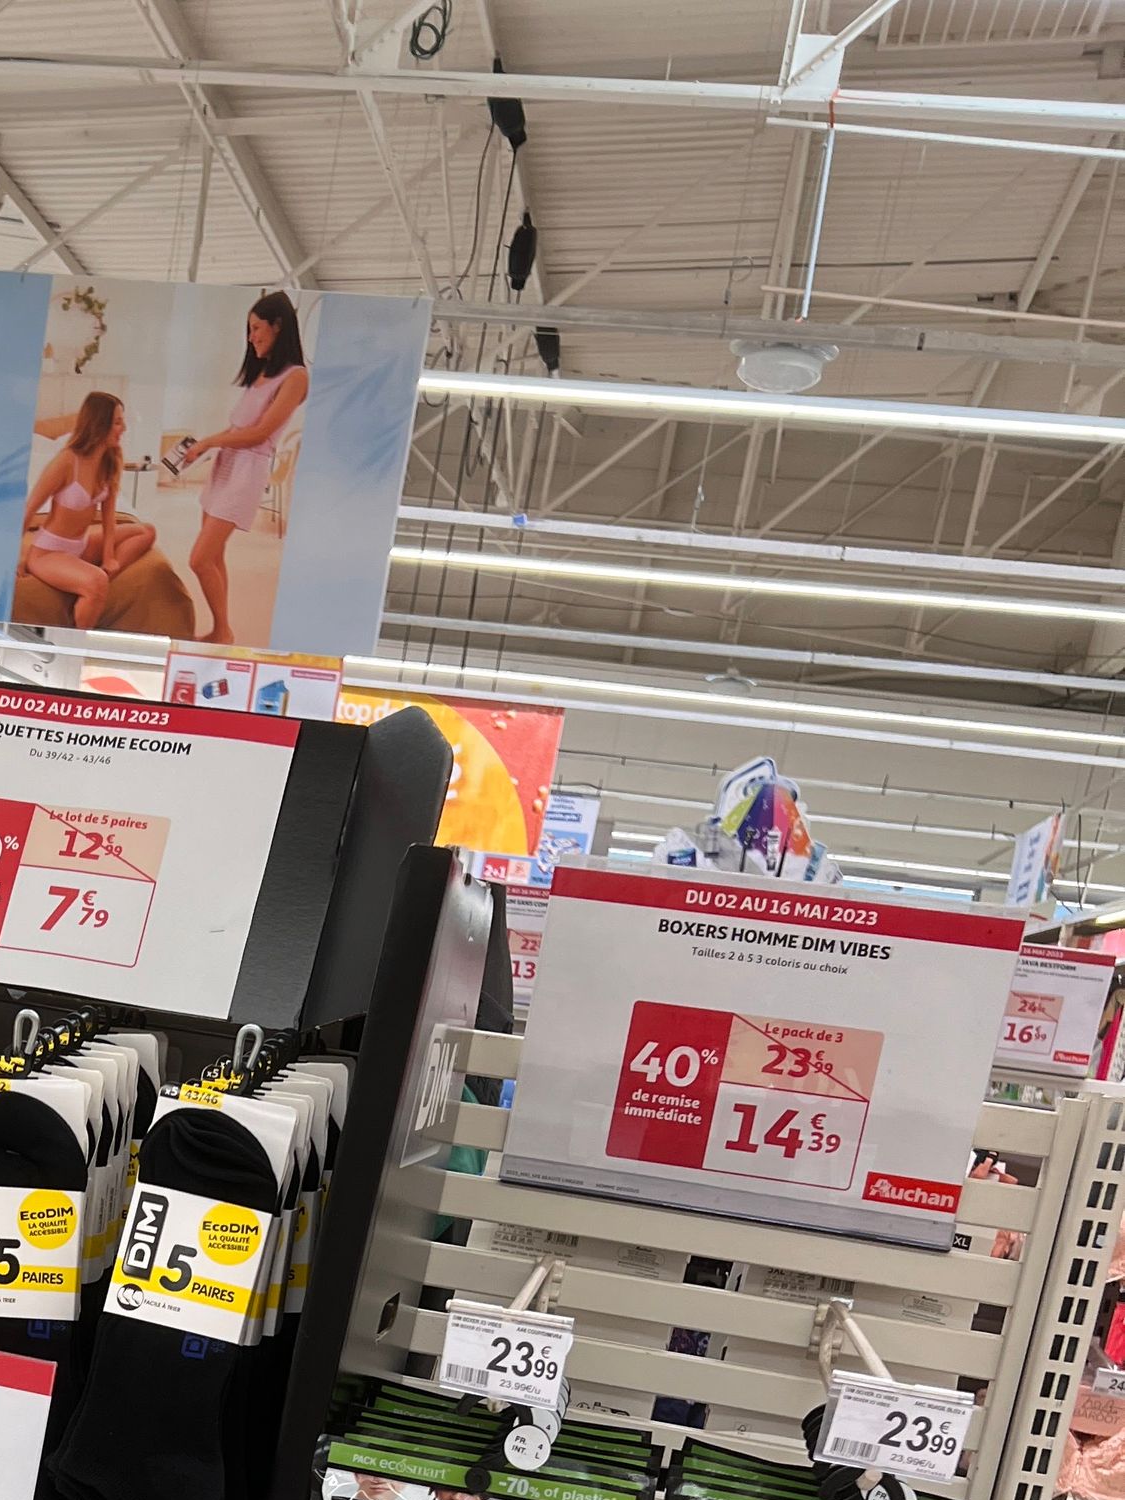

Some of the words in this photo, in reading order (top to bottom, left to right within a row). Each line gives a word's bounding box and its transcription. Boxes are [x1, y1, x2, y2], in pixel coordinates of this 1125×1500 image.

[24, 698, 45, 714] 02
[48, 700, 72, 717] AU
[74, 703, 93, 720] 16
[97, 706, 126, 723] MAI
[129, 708, 169, 726] 2023
[336, 699, 371, 722] top
[66, 731, 125, 750] HOMME
[129, 737, 191, 756] ECODIM
[29, 748, 42, 758] Du
[45, 749, 74, 764] 39/42
[82, 753, 111, 766] 43/46
[49, 810, 63, 822] Le
[66, 812, 82, 824] lot
[84, 813, 98, 825] de
[101, 815, 109, 826] 5
[111, 815, 148, 830] paires
[685, 888, 712, 906] DU
[714, 892, 737, 909] 02
[740, 895, 766, 913] AU
[769, 898, 790, 915] 16
[794, 901, 829, 921] MAI
[832, 906, 878, 926] 2023
[658, 918, 728, 943] BOXERS
[731, 927, 797, 950] HOMME
[801, 935, 835, 953] DIM
[839, 940, 890, 961] VIBES
[692, 946, 726, 962] Tailles
[728, 951, 735, 962] 2
[738, 951, 745, 963] à
[747, 953, 754, 964] 5
[756, 954, 763, 965] 3
[765, 955, 801, 970] coloris
[803, 961, 815, 970] au
[818, 961, 848, 975] choix
[765, 1022, 779, 1036] Le
[781, 1025, 810, 1043] pack
[813, 1029, 831, 1042] de
[834, 1031, 843, 1043] 3
[629, 1041, 719, 1088] 40%
[632, 1089, 649, 1103] de
[652, 1092, 700, 1110] remise
[624, 1103, 702, 1126] immédiate
[869, 1177, 955, 1209] Auchan
[954, 1236, 969, 1249] XL
[22, 1271, 64, 1285] PAIRES
[544, 1487, 560, 1499] of
